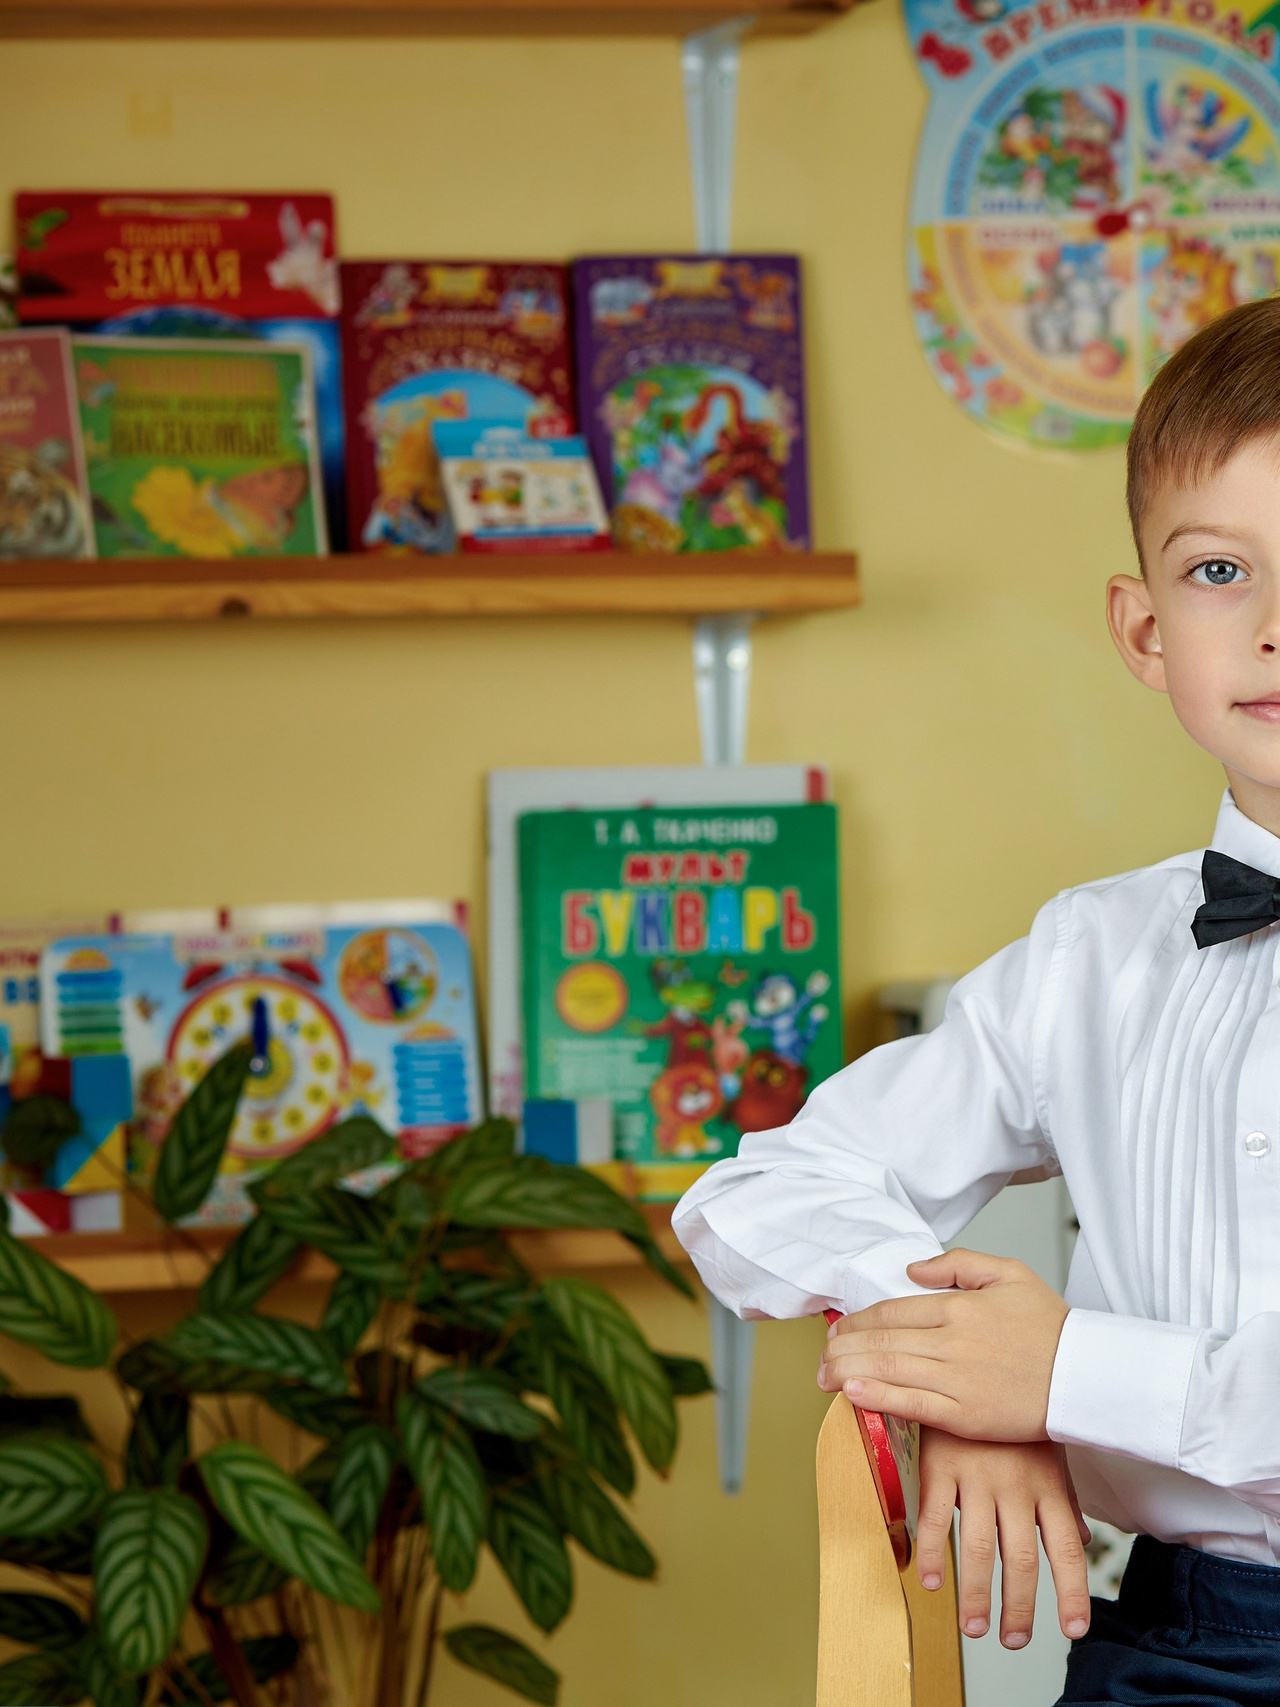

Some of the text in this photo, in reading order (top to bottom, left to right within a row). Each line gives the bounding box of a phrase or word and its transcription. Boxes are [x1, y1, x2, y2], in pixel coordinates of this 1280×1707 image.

[105, 249, 242, 298] ЗЕМЛЯ
[653, 816, 777, 845] ТКАЧЕНКО
[623, 849, 750, 884] МУЛЬТ
[563, 886, 815, 956] БУКВАРЬ
